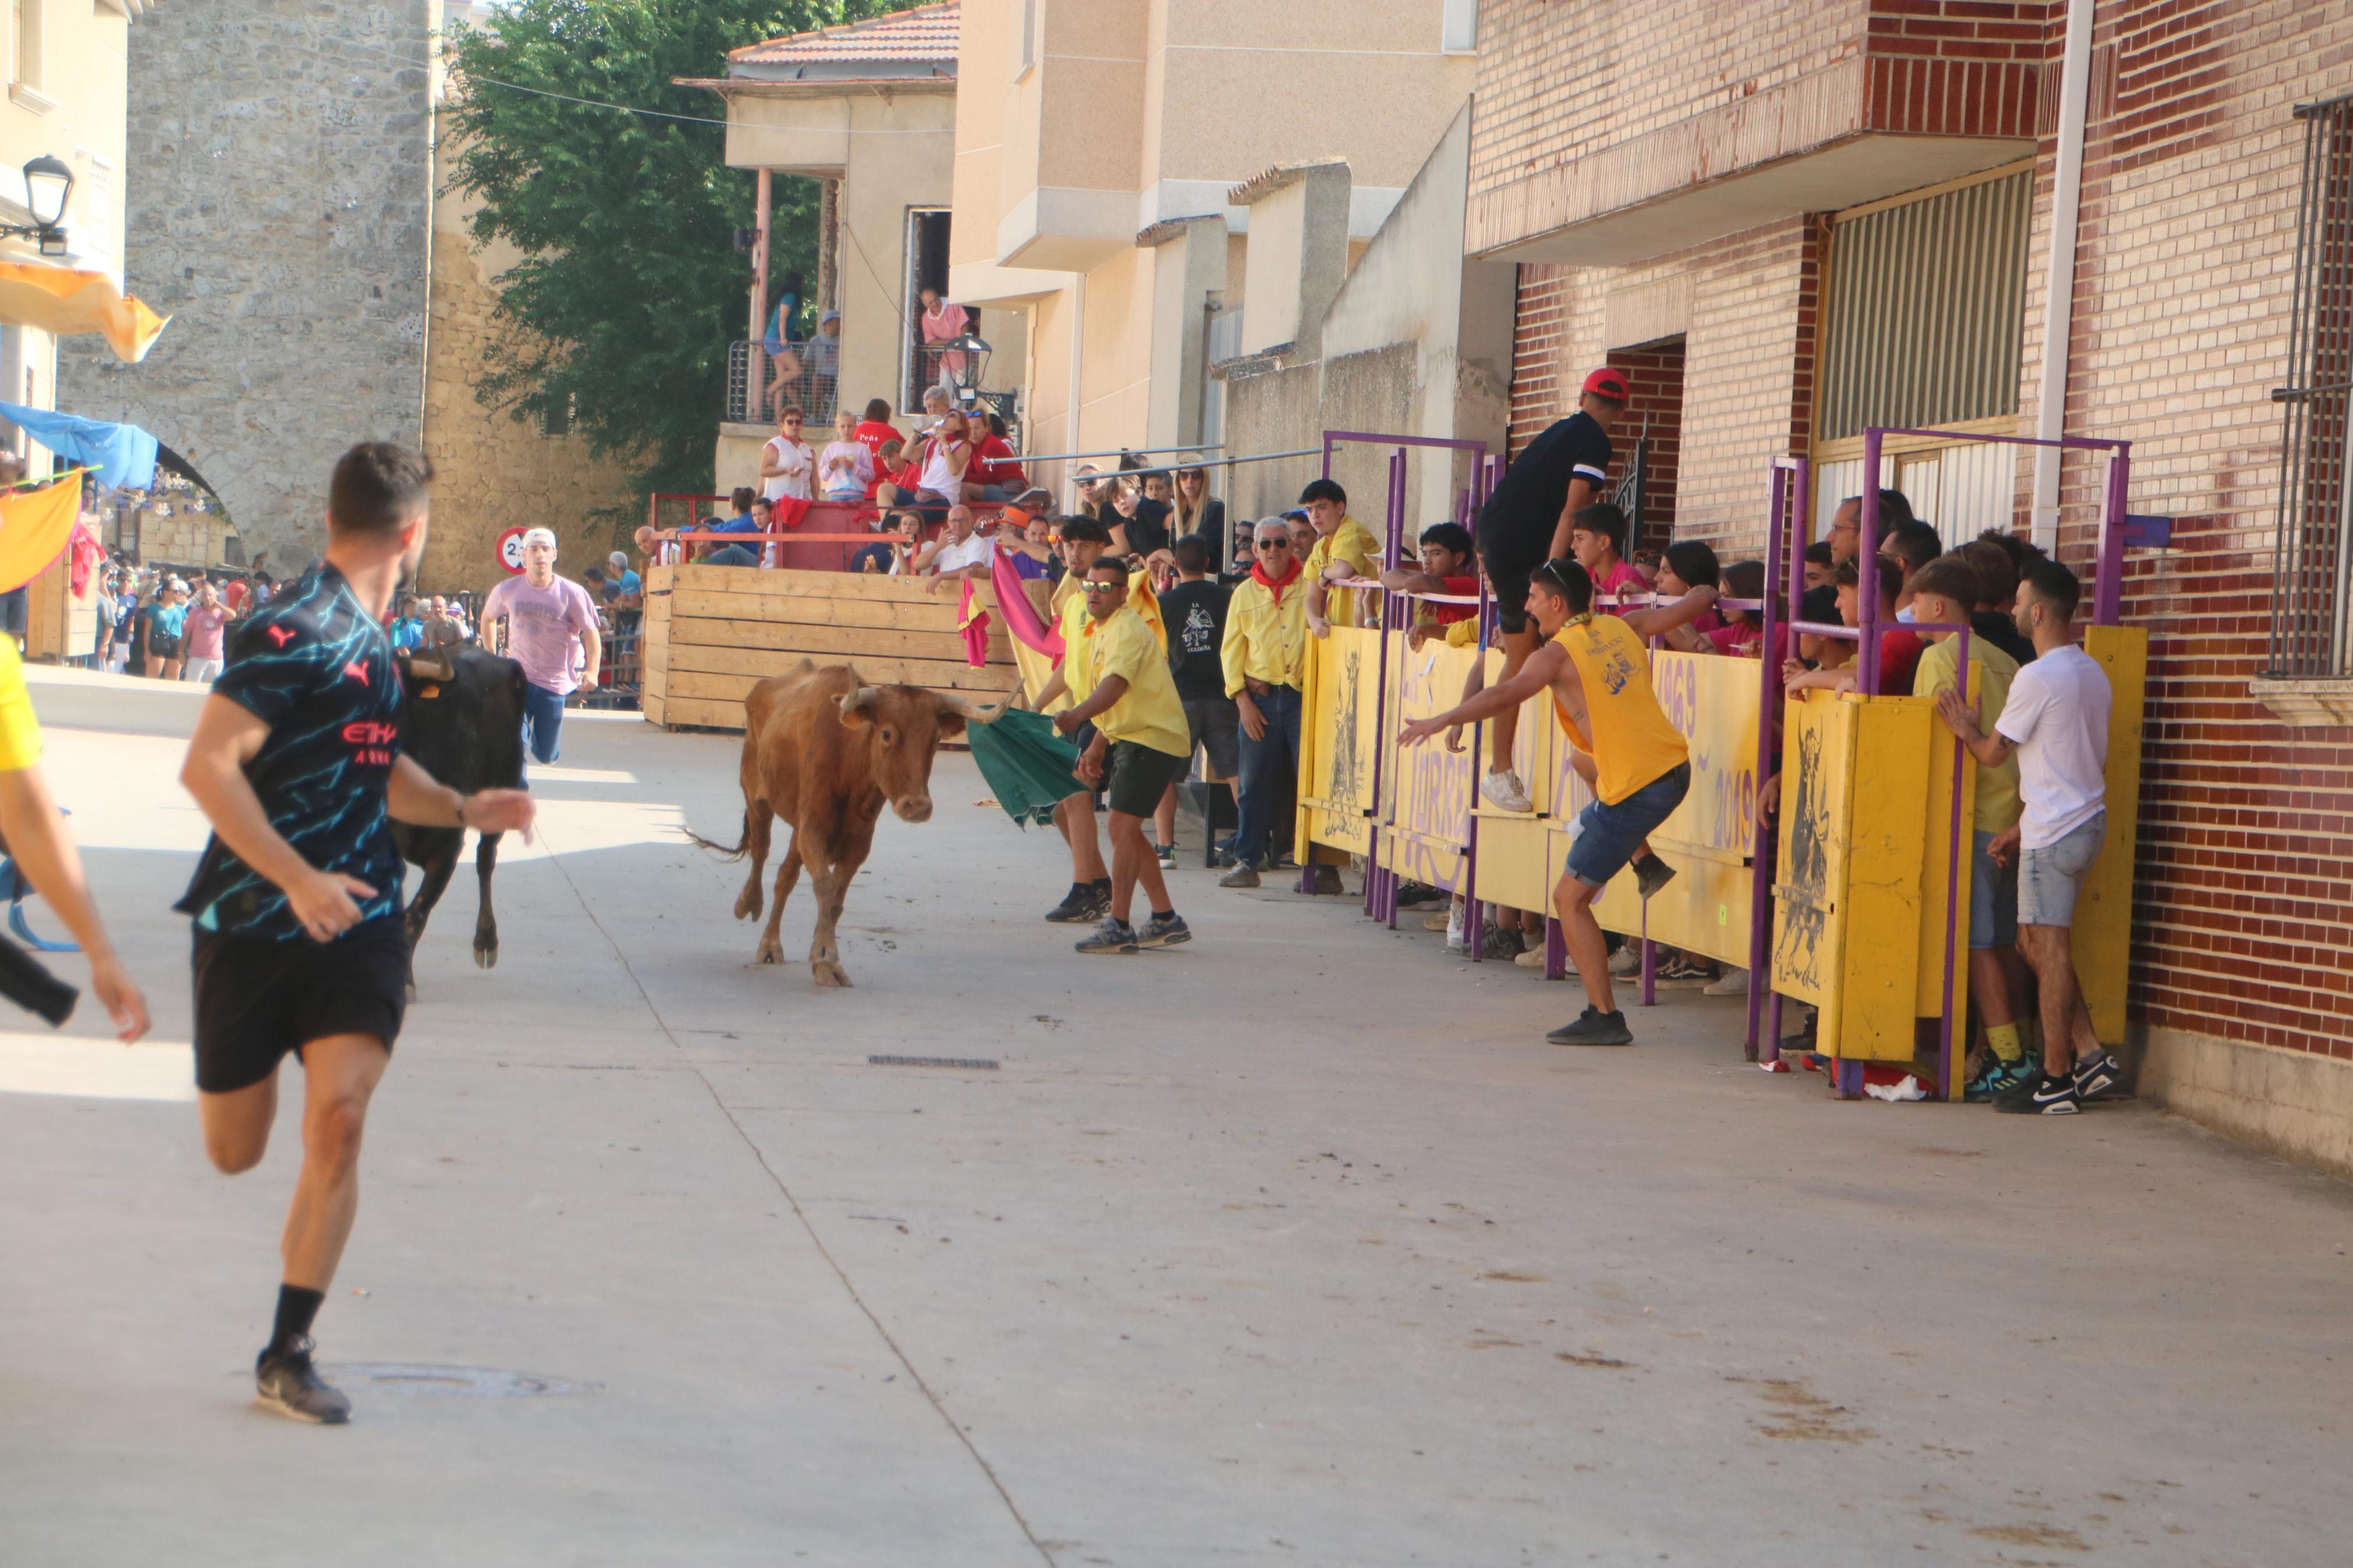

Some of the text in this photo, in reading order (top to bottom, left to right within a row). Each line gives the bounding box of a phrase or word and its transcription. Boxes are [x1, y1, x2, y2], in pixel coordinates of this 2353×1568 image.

[515, 600, 558, 621] PARIS
[1658, 656, 1696, 740] 1969
[1713, 767, 1754, 854] 2019
